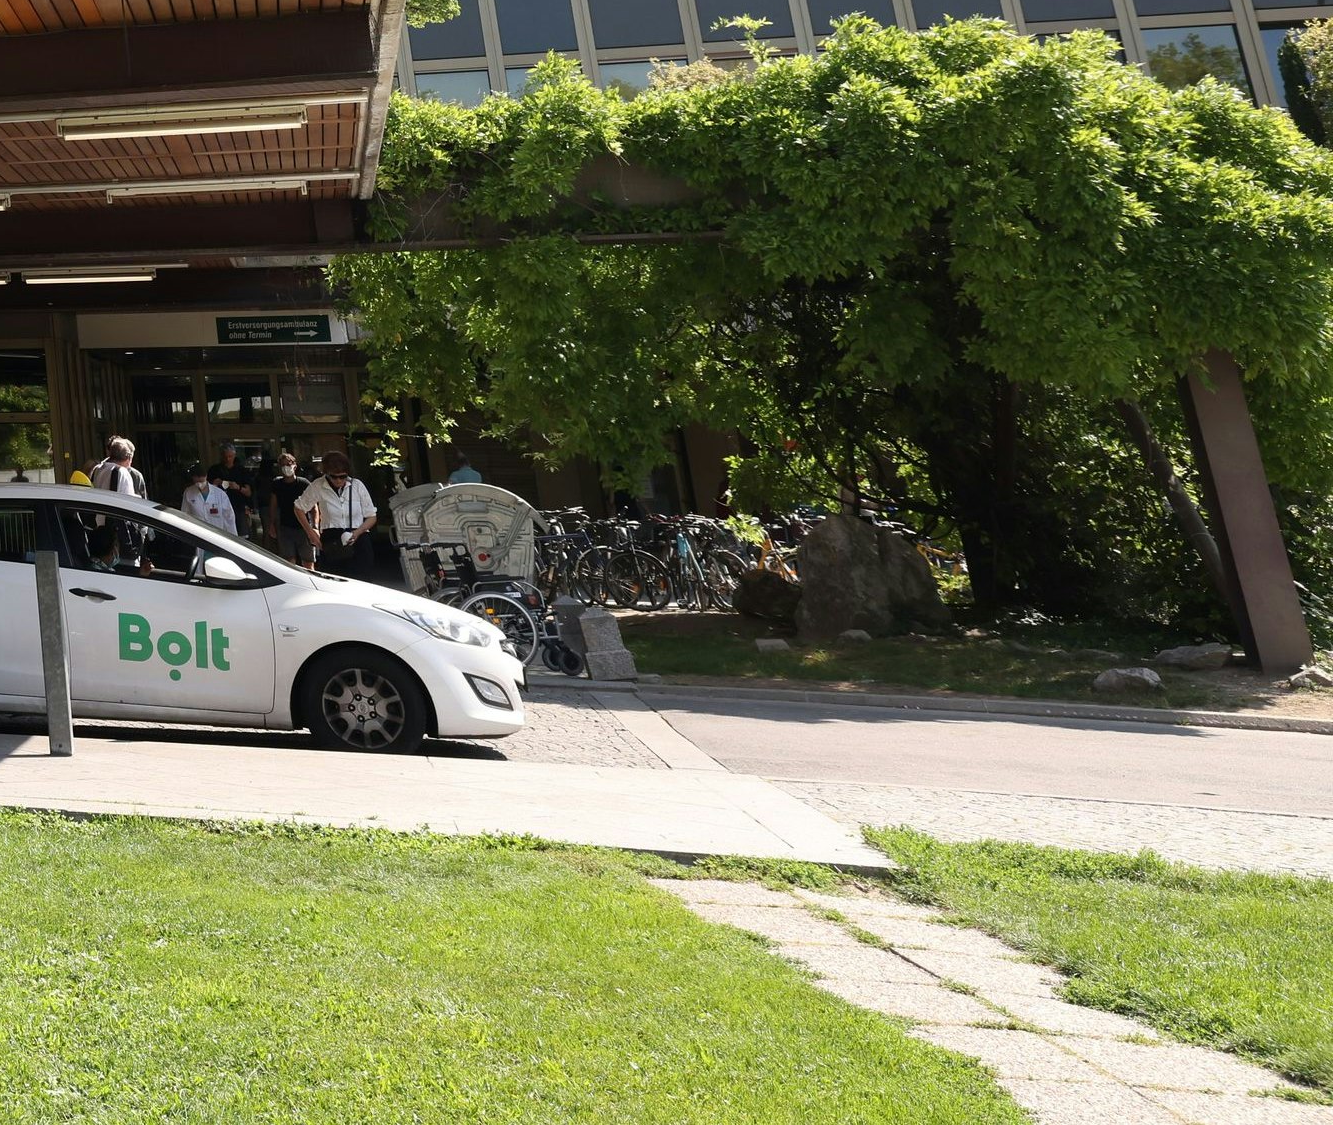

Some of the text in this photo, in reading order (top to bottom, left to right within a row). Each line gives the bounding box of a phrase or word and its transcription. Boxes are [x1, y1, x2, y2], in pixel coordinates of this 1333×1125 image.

[228, 320, 318, 331] Erstversorgungsambulanz
[229, 331, 272, 340] ohne Termin
[118, 612, 231, 682] Bolt
